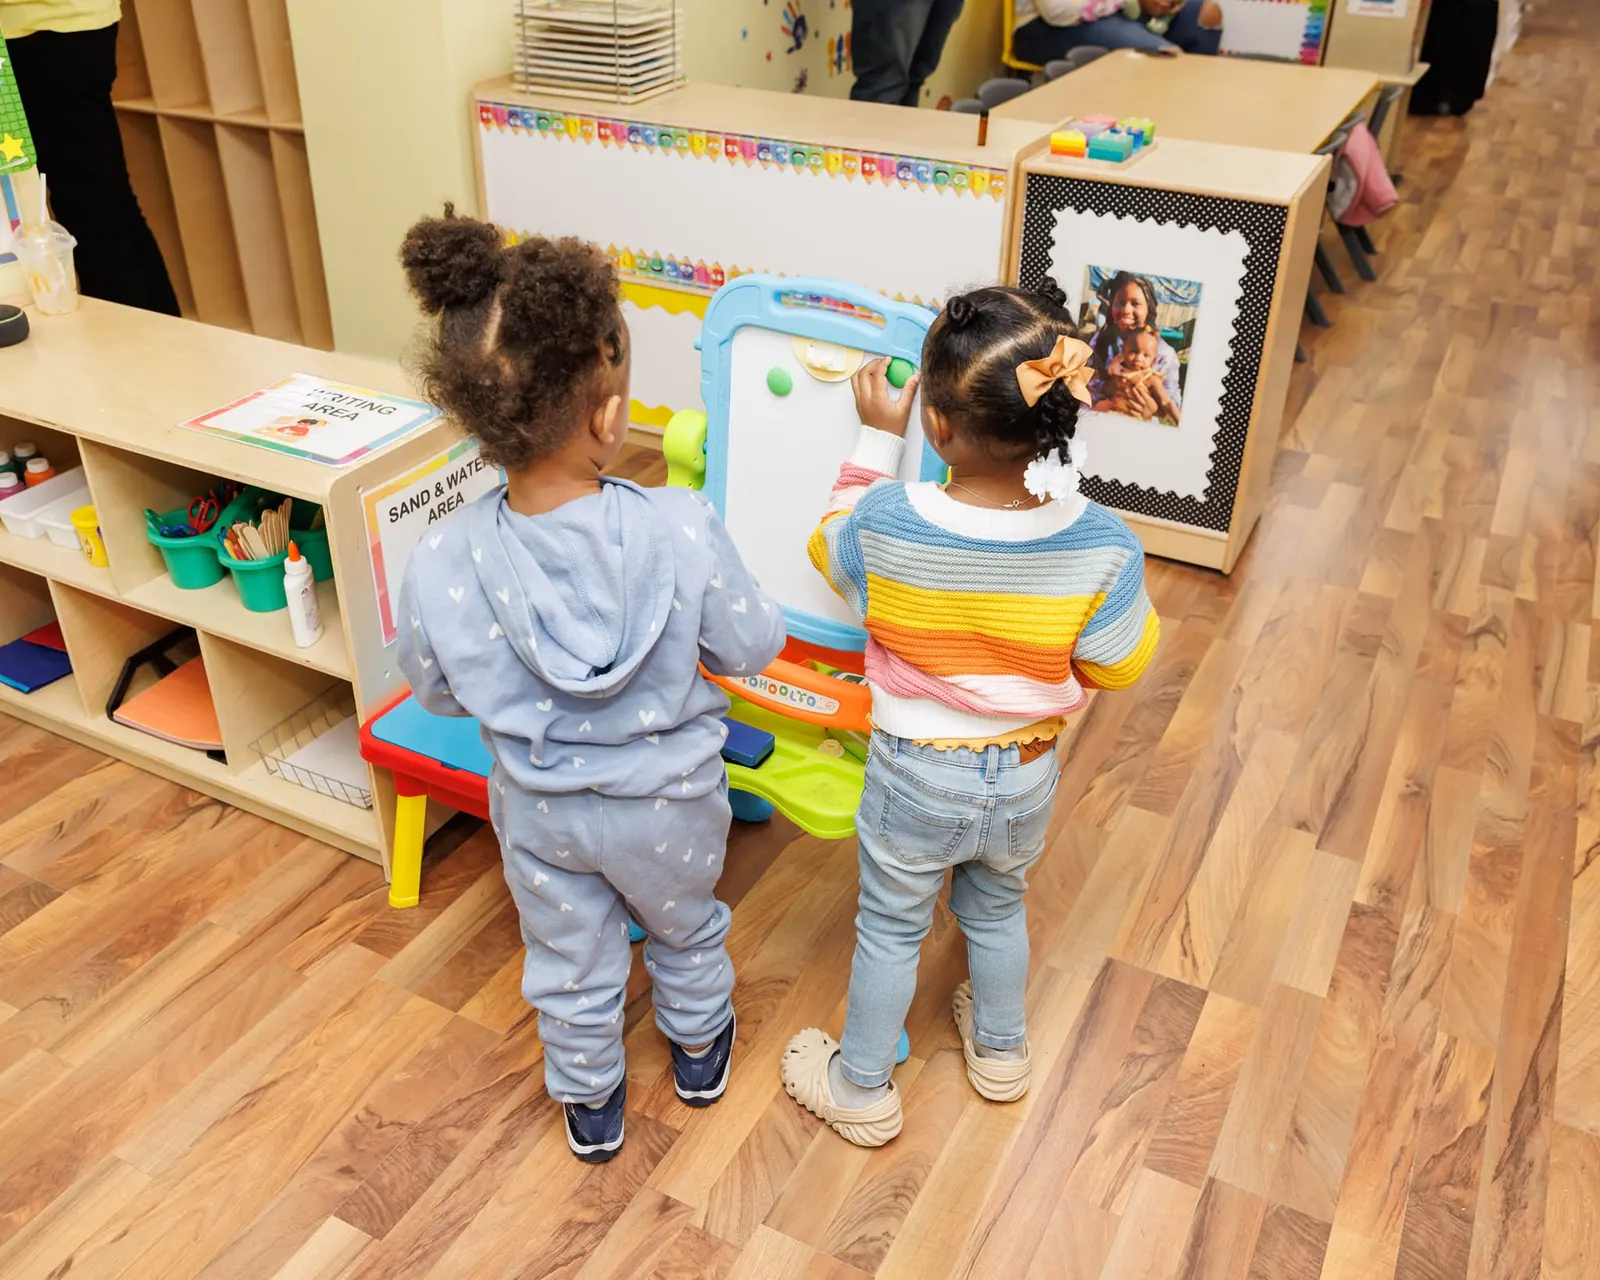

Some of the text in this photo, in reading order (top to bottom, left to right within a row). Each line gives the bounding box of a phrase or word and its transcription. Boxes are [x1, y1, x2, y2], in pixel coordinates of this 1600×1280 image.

[301, 402, 360, 421] AREA
[388, 456, 486, 523] SAND & WATE
[427, 491, 465, 525] AREA
